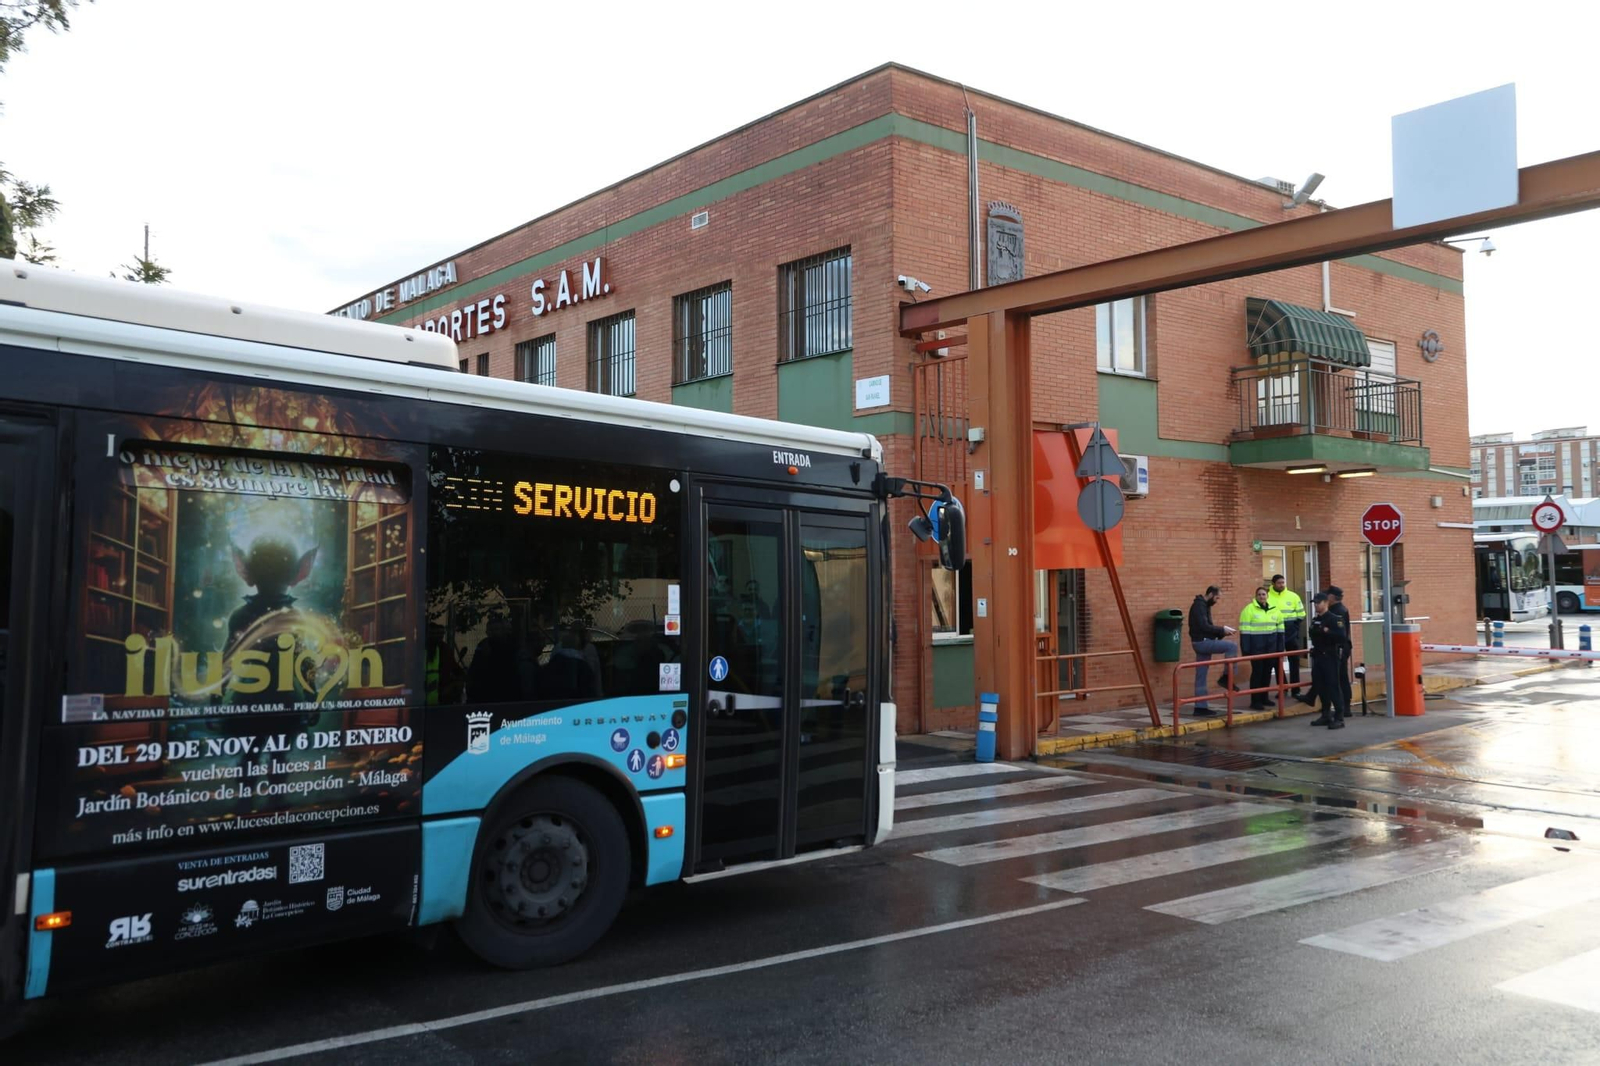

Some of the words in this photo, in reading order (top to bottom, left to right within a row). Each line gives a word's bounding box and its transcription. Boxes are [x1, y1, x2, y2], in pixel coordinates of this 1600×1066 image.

[531, 257, 611, 317] S.A.M.
[375, 288, 392, 313] DE
[143, 451, 226, 474] mejor
[232, 457, 263, 475] de
[269, 459, 295, 478] la
[772, 450, 811, 468] ENTRADA
[165, 472, 195, 487] es
[201, 471, 309, 500] siempre
[513, 481, 656, 524] SERVICIO
[1364, 520, 1400, 531] STOP
[92, 711, 108, 721] LA
[112, 708, 165, 720] NAVIDAD
[167, 706, 201, 717] TIENE
[203, 704, 249, 715] MUCHAS
[293, 702, 319, 711] PERO
[321, 701, 335, 710] UN
[336, 699, 362, 709] SOLO
[363, 696, 406, 707] CORAZÓN
[500, 716, 563, 729] Ayuntamiento
[77, 744, 129, 767] DEL
[135, 742, 162, 762] 29
[167, 740, 200, 760] DE
[205, 736, 259, 757] NOV.
[262, 734, 291, 753] AL
[296, 732, 309, 750] 6
[313, 730, 341, 749] DE
[345, 726, 413, 747] ENERO
[500, 734, 511, 745] de
[513, 732, 547, 745] Málaga
[181, 764, 243, 782] vuelven
[247, 761, 268, 777] las
[272, 758, 310, 775] luces
[314, 755, 326, 771] al
[76, 794, 131, 818] Jardín
[136, 788, 209, 809] Botánico
[214, 784, 234, 800] de
[238, 783, 252, 798] la
[256, 775, 343, 797] Concepción
[358, 770, 408, 787] Málaga
[112, 828, 143, 845] más
[146, 824, 174, 841] info
[177, 825, 194, 837] en
[198, 804, 380, 834] www.lucesdelaconcepcion.es
[178, 859, 208, 870] VENTA
[210, 857, 223, 867] DE
[224, 851, 269, 865] ENTRADAS
[347, 886, 372, 897] Ciudad
[347, 897, 356, 905] de
[357, 893, 381, 904] Málaga
